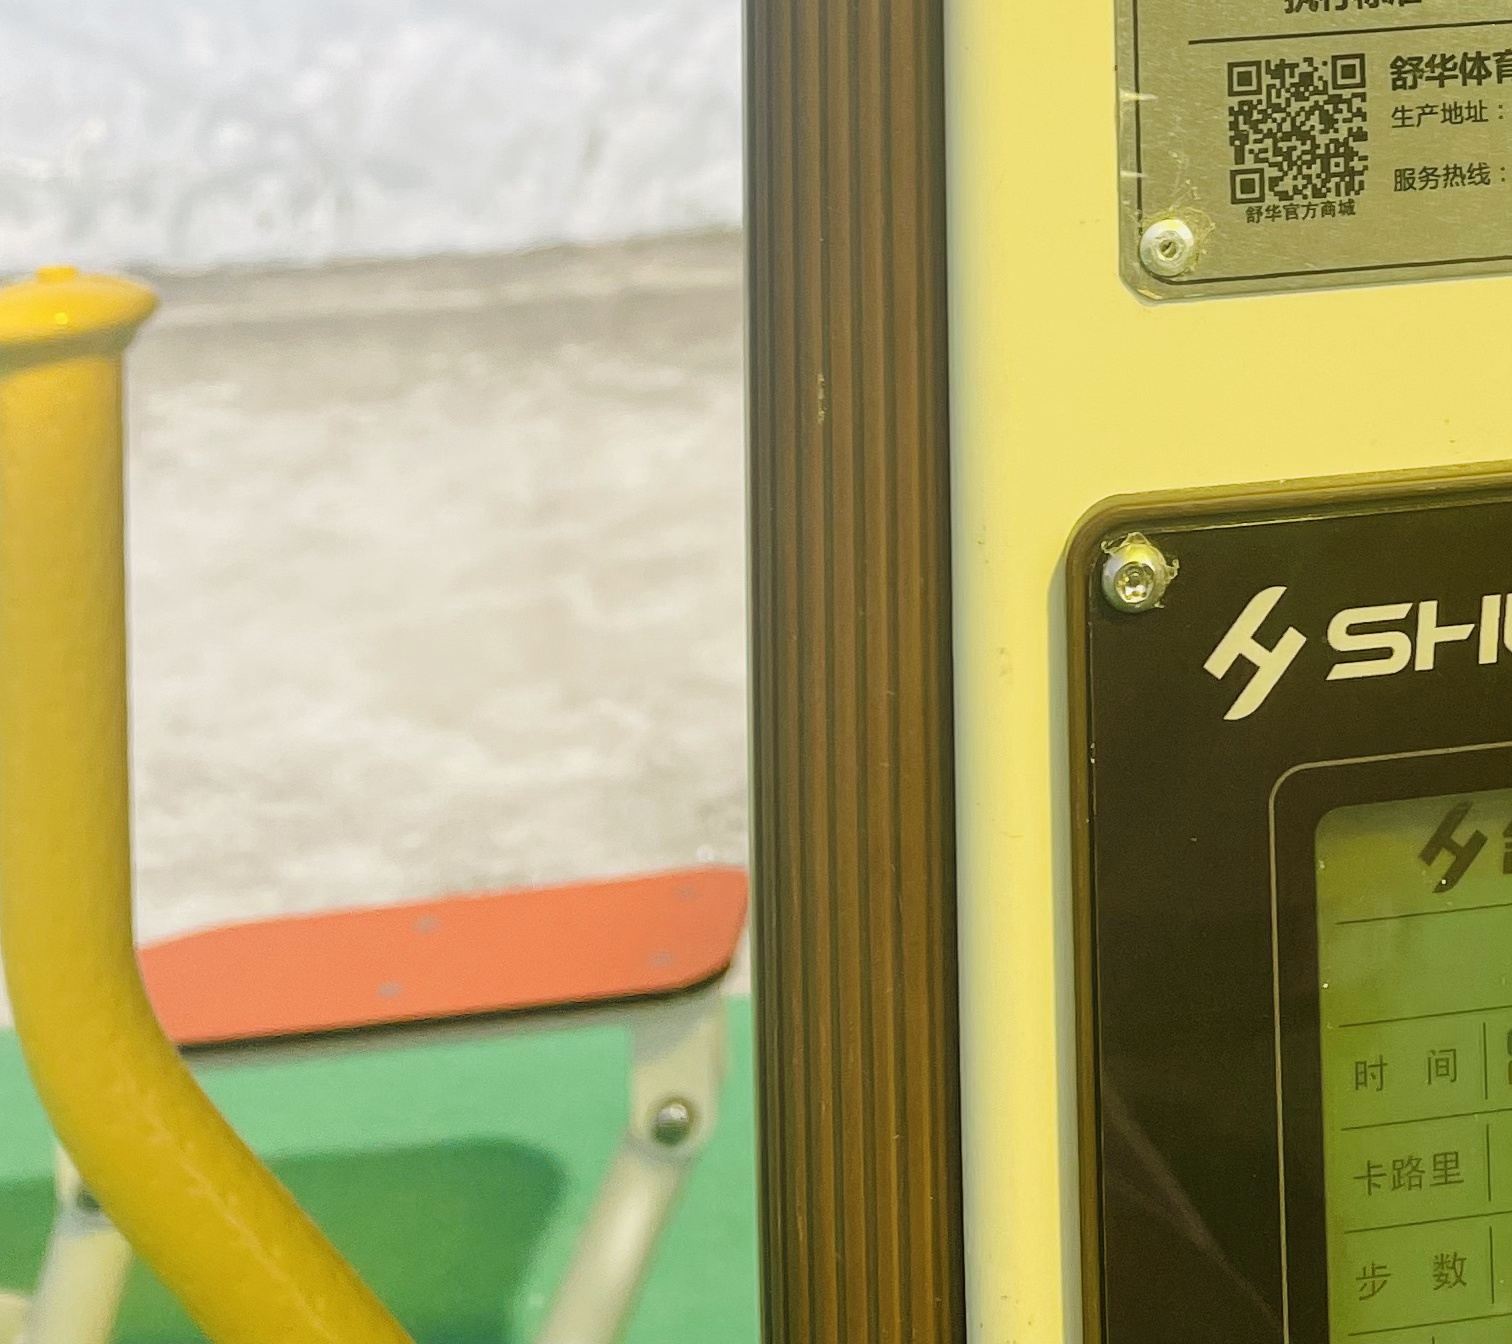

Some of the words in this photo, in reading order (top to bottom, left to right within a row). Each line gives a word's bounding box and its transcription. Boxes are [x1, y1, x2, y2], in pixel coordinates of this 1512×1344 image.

[1245, 200, 1355, 223] 舒华官方商城
[1354, 1151, 1463, 1196] 卡路里
